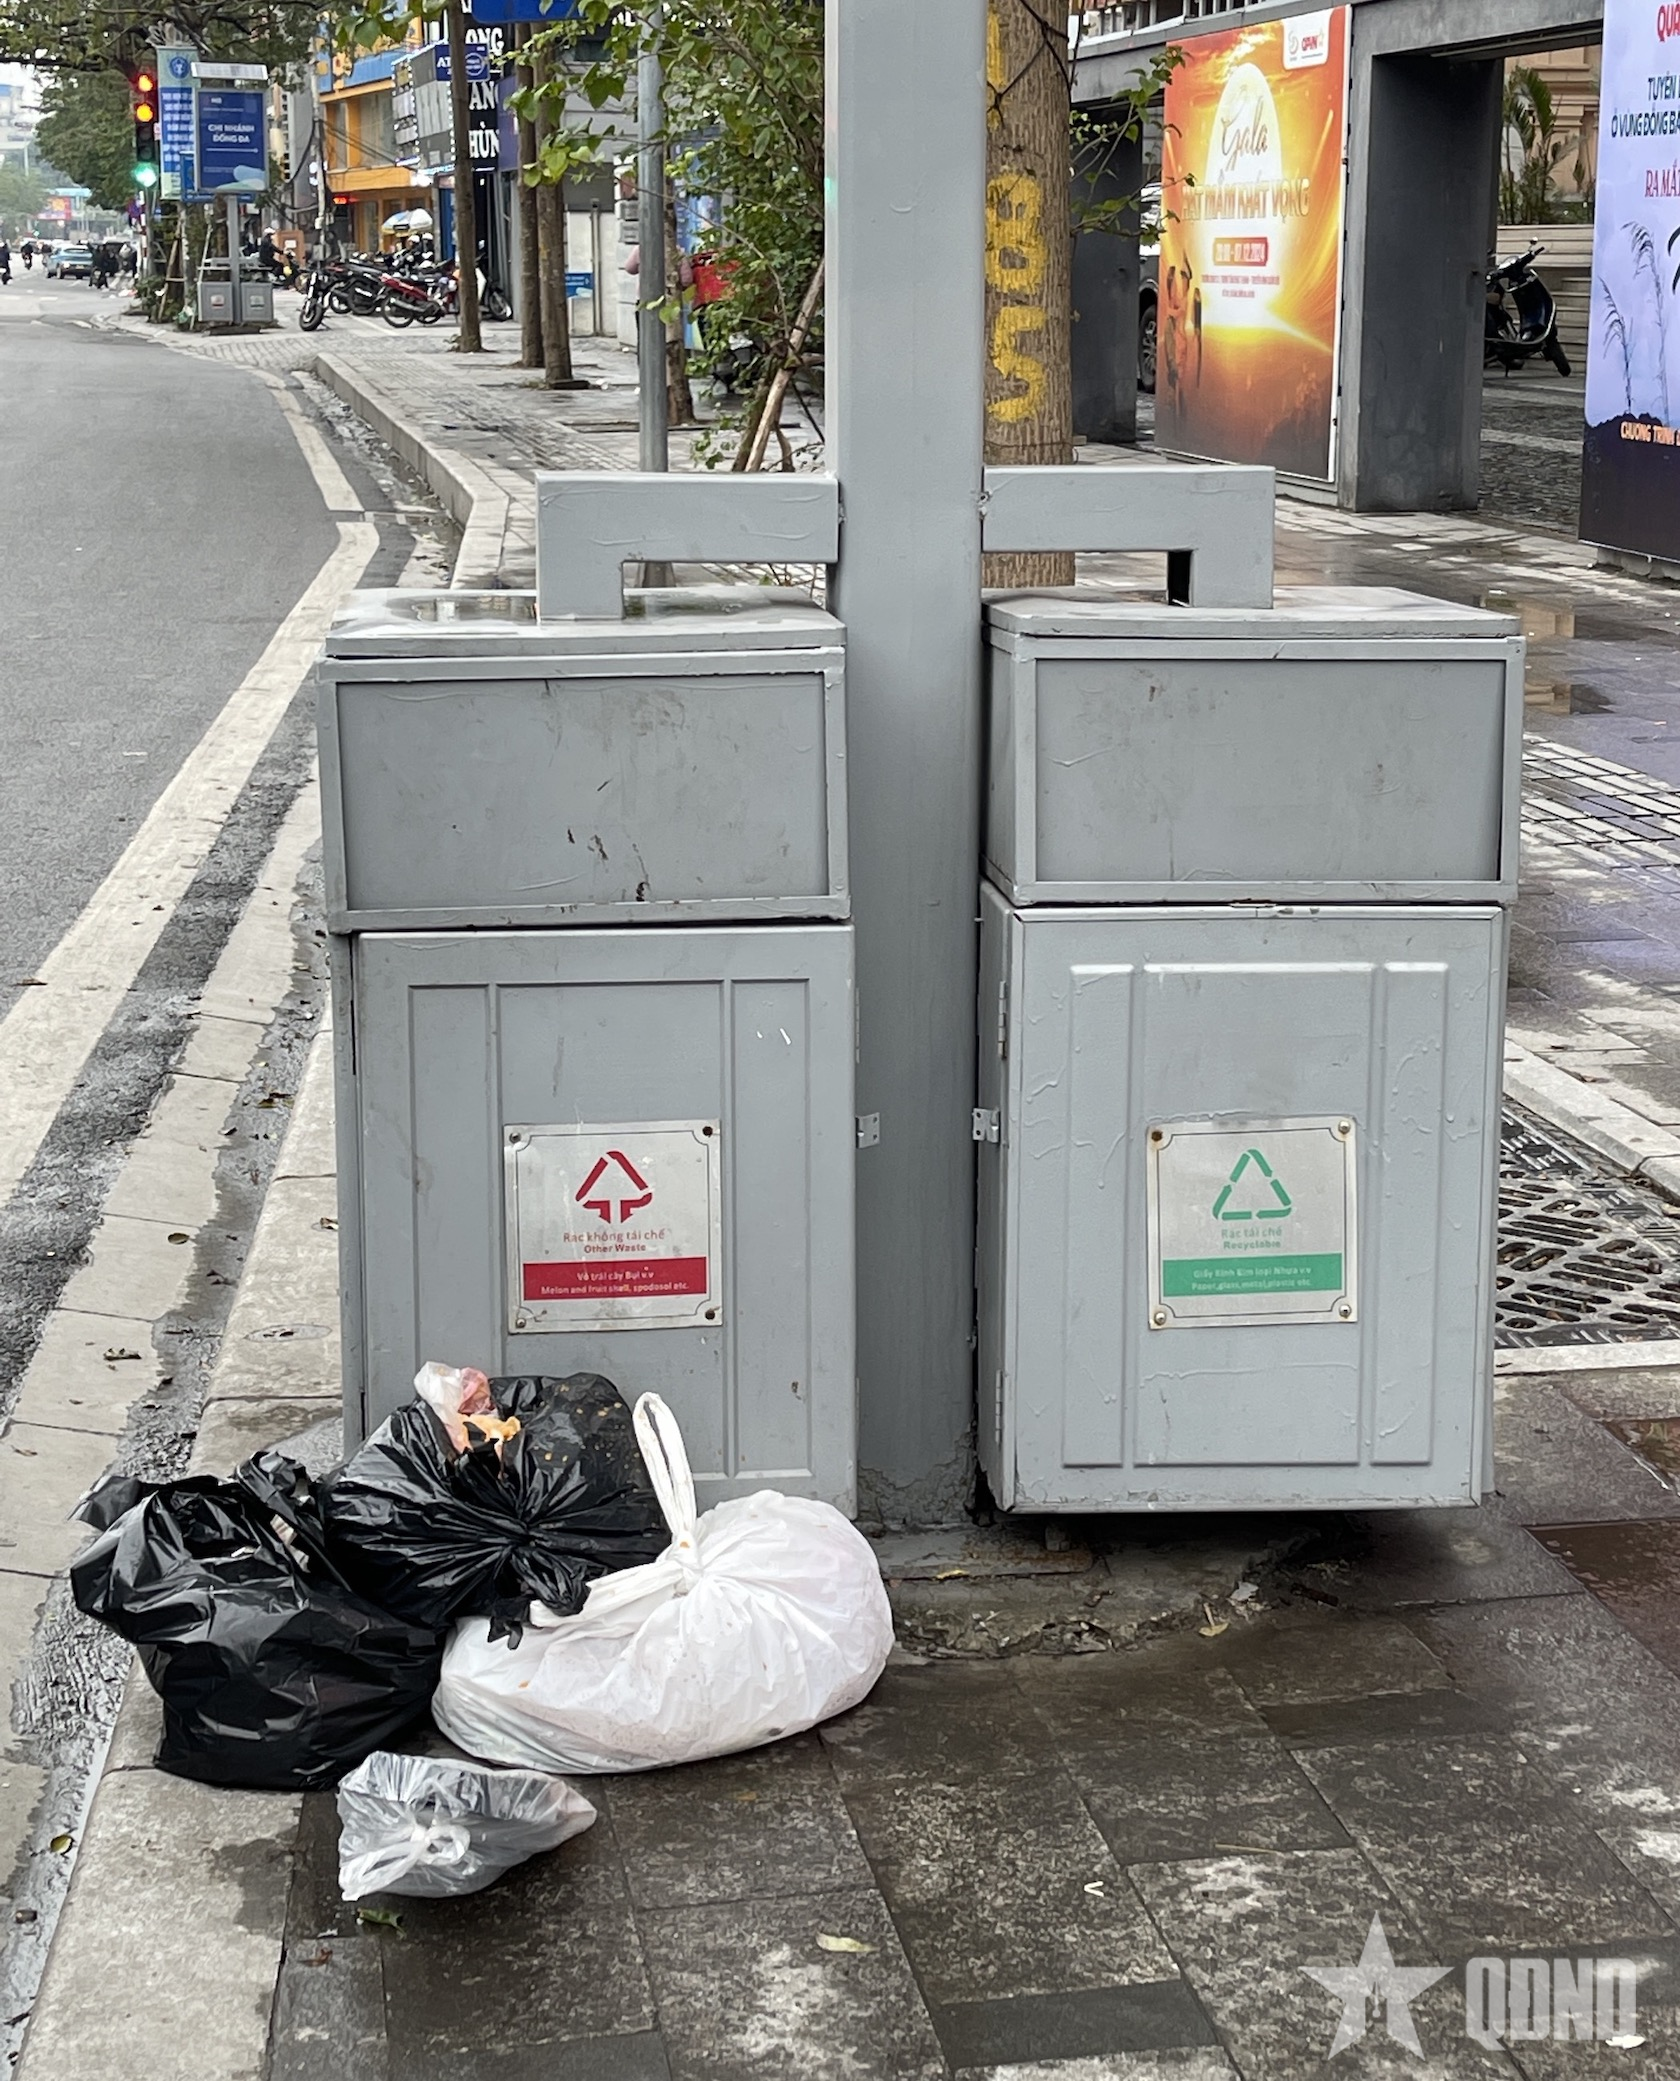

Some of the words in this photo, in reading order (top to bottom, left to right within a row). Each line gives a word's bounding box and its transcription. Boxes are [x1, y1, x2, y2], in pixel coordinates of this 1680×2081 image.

[437, 57, 453, 70] AT
[1221, 85, 1268, 172] Gala
[584, 1244, 612, 1254] Other
[615, 1243, 646, 1253] Waste
[1223, 1239, 1281, 1251] Recyclable
[541, 1286, 569, 1295] Melon
[571, 1285, 587, 1294] and
